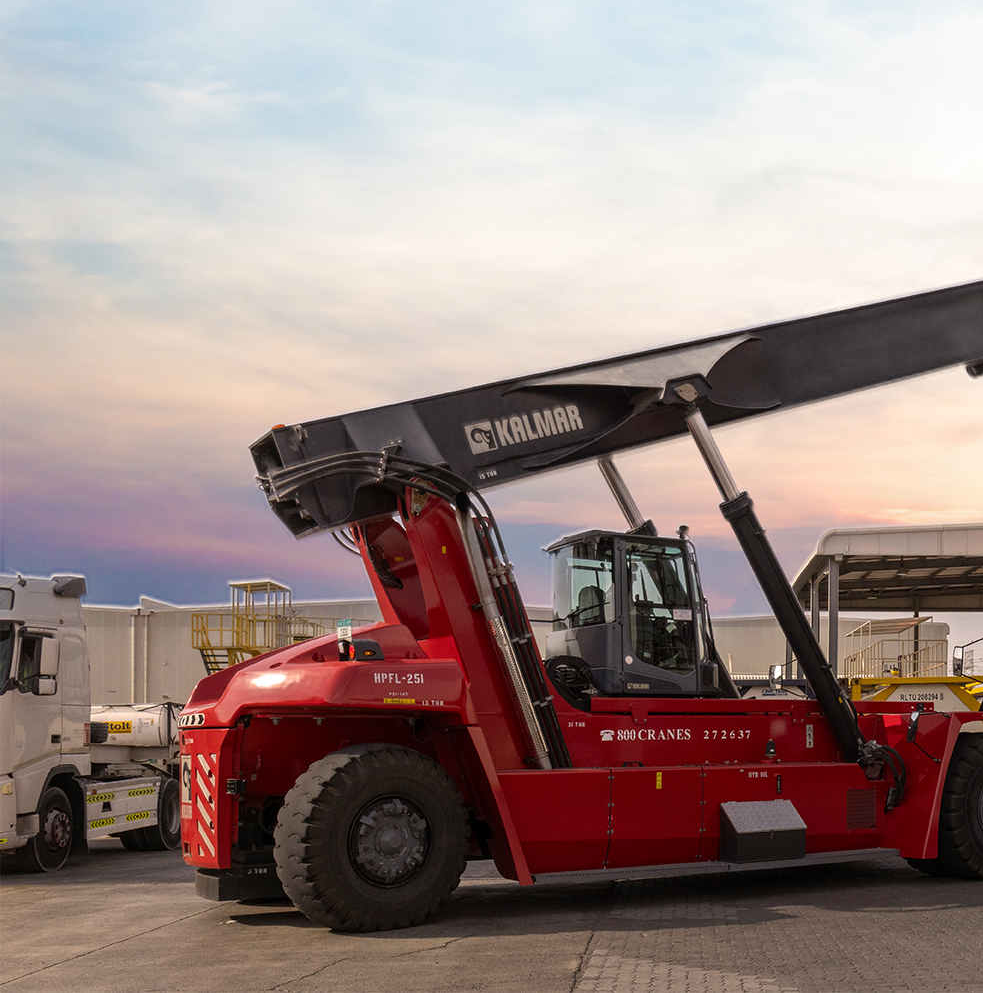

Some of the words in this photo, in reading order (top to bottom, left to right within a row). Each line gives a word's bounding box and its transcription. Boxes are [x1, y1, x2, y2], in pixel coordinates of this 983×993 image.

[495, 405, 584, 447] KALMAR
[373, 672, 424, 684] HPFL-251
[900, 693, 917, 701] RLTU
[917, 691, 939, 701] 208294
[107, 721, 131, 730] tolt
[617, 729, 636, 741] 800
[637, 728, 691, 741] CRANES
